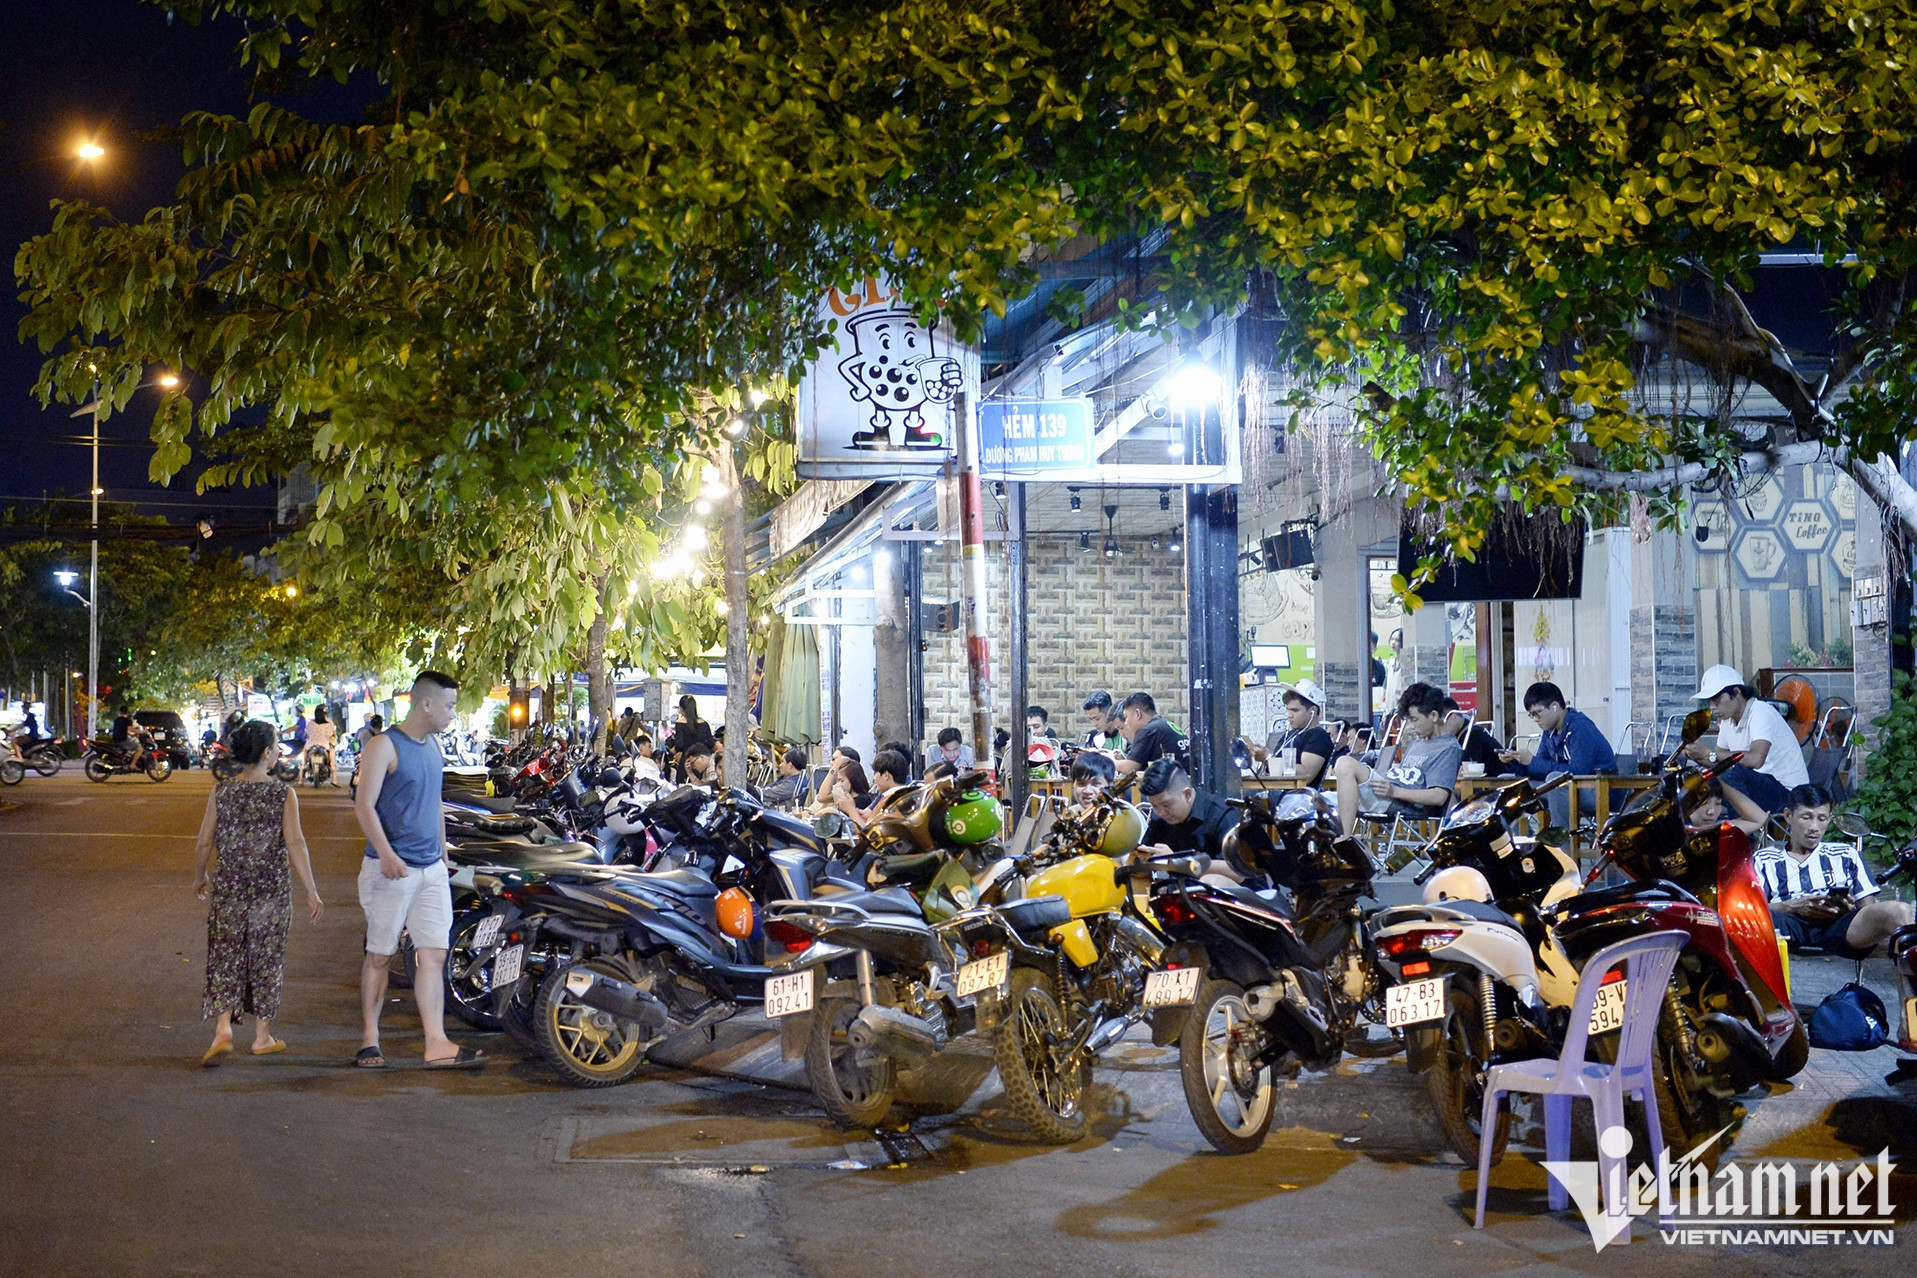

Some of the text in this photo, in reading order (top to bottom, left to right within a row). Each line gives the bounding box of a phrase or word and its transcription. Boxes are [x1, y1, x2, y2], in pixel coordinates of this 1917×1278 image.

[1002, 406, 1067, 439] HẺM 139
[1039, 445, 1056, 461] HUY
[1796, 524, 1828, 539] Coffee
[966, 956, 1000, 979] 21-E1
[773, 975, 804, 996] 61-H1
[960, 969, 1003, 994] 097.87
[1154, 970, 1191, 988] 70-K1
[768, 992, 808, 1015] 092.41
[1395, 982, 1435, 1003] 47-B3
[1390, 999, 1440, 1023] 063.17
